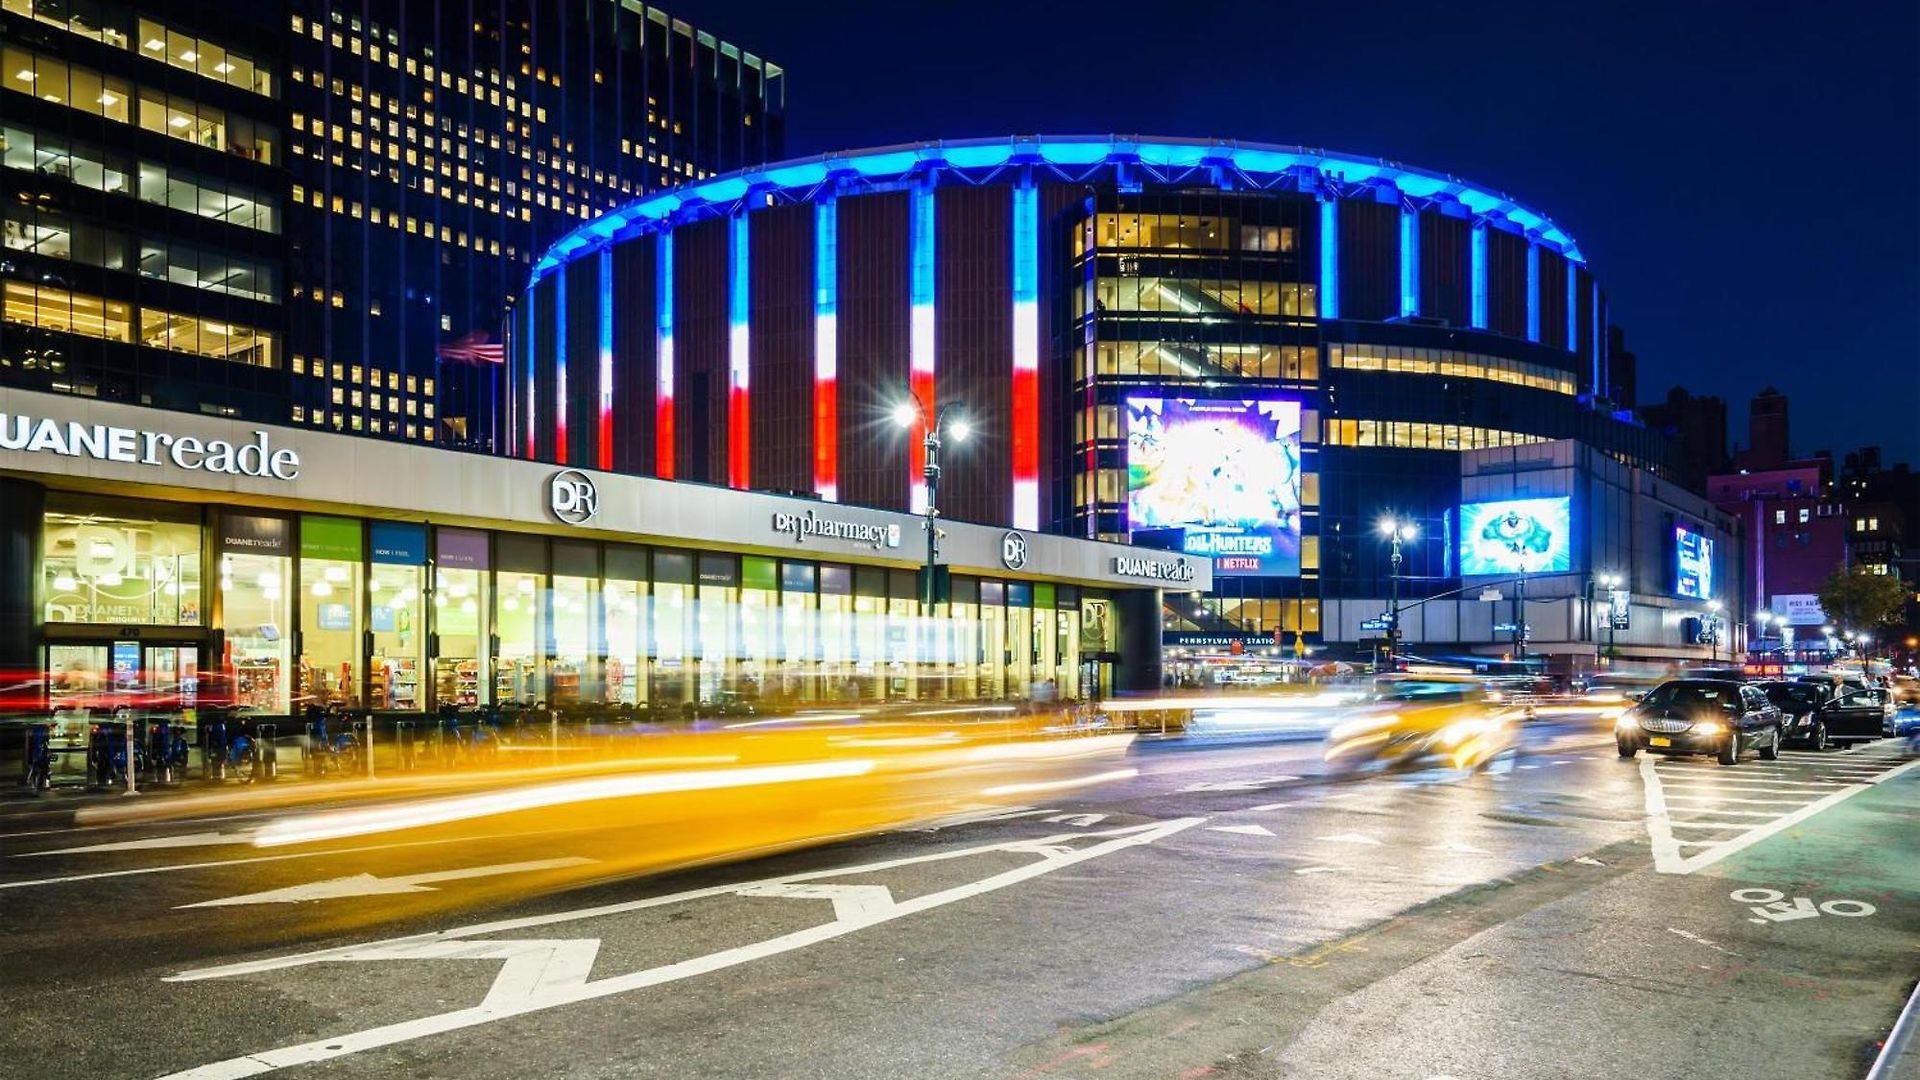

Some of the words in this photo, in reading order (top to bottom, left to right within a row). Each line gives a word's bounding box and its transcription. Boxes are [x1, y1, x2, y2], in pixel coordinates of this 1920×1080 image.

[553, 480, 598, 515] DR
[776, 513, 795, 531] DR
[799, 510, 888, 549] pharmacy
[1004, 539, 1026, 563] DR
[1223, 558, 1259, 569] NETFLIX
[1117, 556, 1194, 581] DUANEreade
